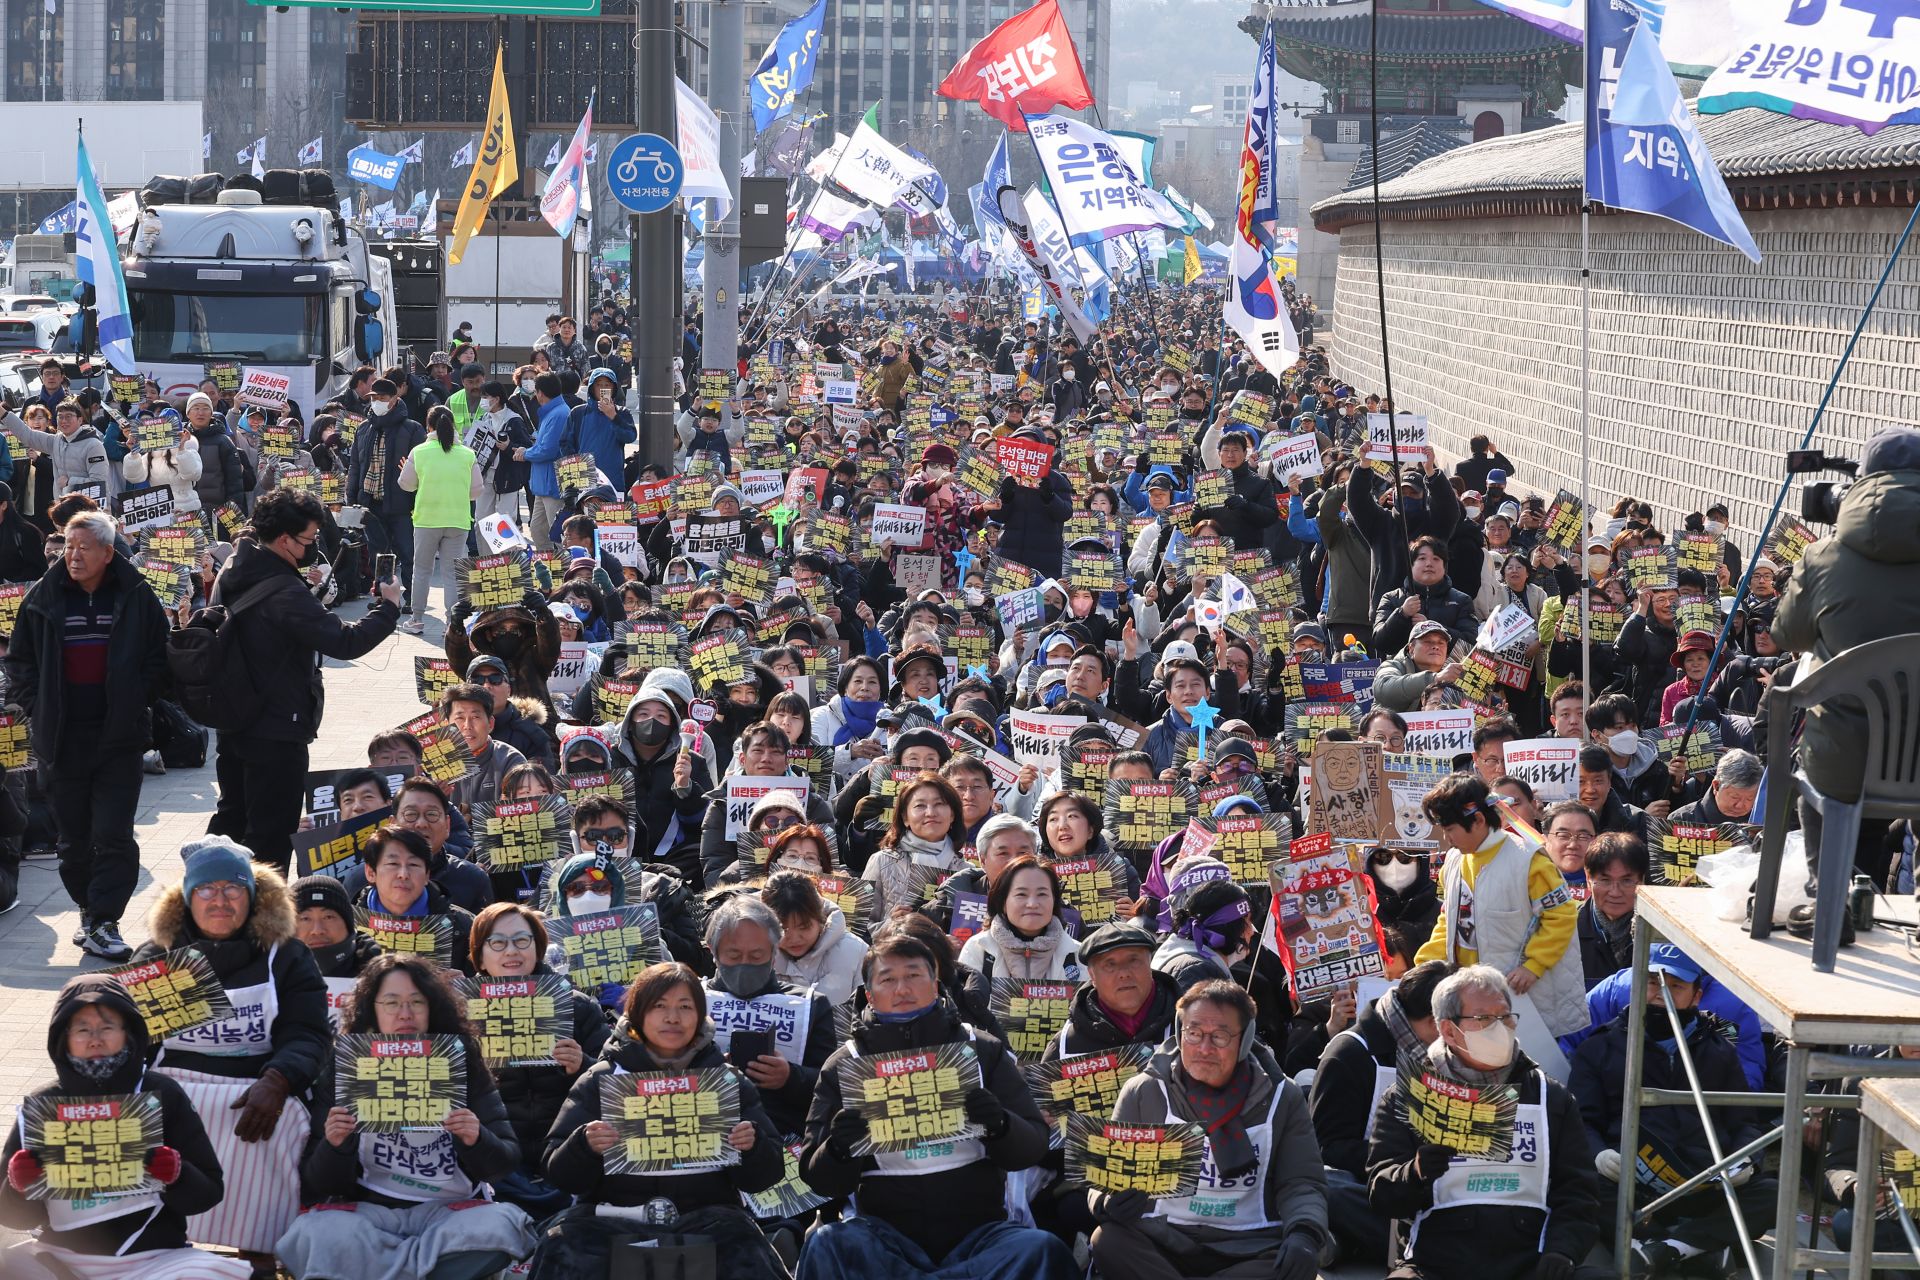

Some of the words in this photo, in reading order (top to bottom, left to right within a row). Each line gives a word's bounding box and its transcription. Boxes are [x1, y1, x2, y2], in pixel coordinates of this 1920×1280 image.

[1033, 122, 1069, 139] 민주당
[1623, 130, 1689, 178] 지역
[621, 187, 670, 197] 자전거전용
[248, 373, 288, 389] 내란세력
[829, 385, 852, 396] 은평을
[1021, 462, 1040, 476] 혁명
[744, 482, 782, 496] 해체하라!
[122, 488, 168, 513] 윤석열을
[125, 501, 174, 527] 파면하라!
[689, 520, 741, 538] 윤석열을
[873, 520, 922, 535] 해체하라!
[688, 534, 745, 552] 파면하라!
[479, 557, 507, 568] 내란수괴
[734, 554, 763, 568] 내란수괴
[902, 557, 935, 571] 윤석열
[468, 564, 521, 583] 윤석열을
[726, 559, 769, 582] 윤석열을
[905, 572, 928, 585] 탄핵
[471, 588, 525, 605] 파면하라
[1013, 590, 1037, 609] 즉각
[762, 615, 788, 628] 내란수괴
[1014, 605, 1038, 625] 파면
[626, 633, 677, 646] 윤석열을
[958, 628, 980, 636] 내란수괴
[695, 638, 721, 653] 내란수괴
[948, 636, 989, 649] 윤석열을
[628, 654, 678, 667] 파면하라
[690, 642, 740, 669] 윤석열을
[1475, 654, 1494, 667] 내란수괴
[433, 662, 451, 670] 내란수
[1347, 670, 1375, 678] 만장일치
[699, 665, 744, 690] 파면하라
[607, 682, 633, 693] 내란수괴
[1308, 706, 1336, 715] 내란수괴
[1463, 701, 1488, 715] 내란수괴
[409, 716, 435, 731] 내란수괴
[1013, 718, 1046, 734] 내란동조
[1297, 716, 1350, 729] 윤석열을
[1438, 718, 1471, 729] 국민의힘
[1506, 751, 1535, 763] 내란동조
[1537, 750, 1575, 760] 국민의힘
[1363, 746, 1380, 798] 페미니스트가
[573, 775, 605, 786] 내란수괴
[731, 787, 770, 797] 내란동조
[1135, 785, 1166, 794] 내란수괴
[1204, 785, 1234, 798] 내란수괴
[1120, 796, 1186, 812] 윤석열을
[1328, 787, 1369, 811] 사형!
[499, 803, 533, 814] 내란수괴
[486, 811, 555, 835] 윤석열을
[1221, 820, 1255, 831] 내란수괴
[1676, 827, 1712, 837] 내란수괴
[489, 841, 558, 865] 파면하라
[1055, 863, 1090, 874] 내란수괴
[818, 880, 837, 890] 수괴
[1180, 870, 1201, 886] 단결
[1569, 888, 1585, 898] 수괴
[1079, 901, 1116, 920] 하라
[373, 919, 412, 932] 내란수괴
[578, 918, 617, 932] 내란수괴
[564, 928, 642, 953] 윤석열을
[117, 965, 159, 984] 내란수괴
[1297, 953, 1381, 989] 차별금지법
[485, 982, 528, 995] 내란수괴
[1028, 986, 1067, 997] 내란수괴
[468, 997, 554, 1019] 윤석열을
[712, 1000, 745, 1011] 윤석열
[750, 1003, 795, 1020] 즉각파면
[1010, 997, 1068, 1019] 윤석열
[376, 1041, 424, 1054] 내란수괴
[357, 1057, 449, 1080] 윤석열을
[881, 1056, 928, 1074] 내란수괴
[1066, 1057, 1110, 1076] 내란수괴
[644, 1079, 689, 1093] 내란수괴
[863, 1066, 960, 1101] 윤석열을
[1052, 1066, 1138, 1100] 윤석열을
[1427, 1076, 1470, 1099] 내란수괴
[624, 1092, 719, 1120] 윤석열을
[1409, 1078, 1497, 1123] 윤석열을
[63, 1105, 111, 1118] 내란수괴
[357, 1098, 450, 1121] 파면하라
[44, 1119, 142, 1145] 윤석열을
[869, 1108, 966, 1143] 파면하라
[1409, 1107, 1491, 1153] 파면하라
[1514, 1121, 1534, 1135] 파면
[1109, 1128, 1156, 1140] 내란수괴
[626, 1133, 722, 1161] 파면하라
[1087, 1134, 1183, 1161] 윤석열을
[373, 1142, 456, 1177] 단식농성
[45, 1161, 144, 1188] 파면하라
[1086, 1166, 1179, 1192] 파면하라
[1466, 1178, 1520, 1192] 비상행동
[1188, 1201, 1236, 1217] 비상행동
